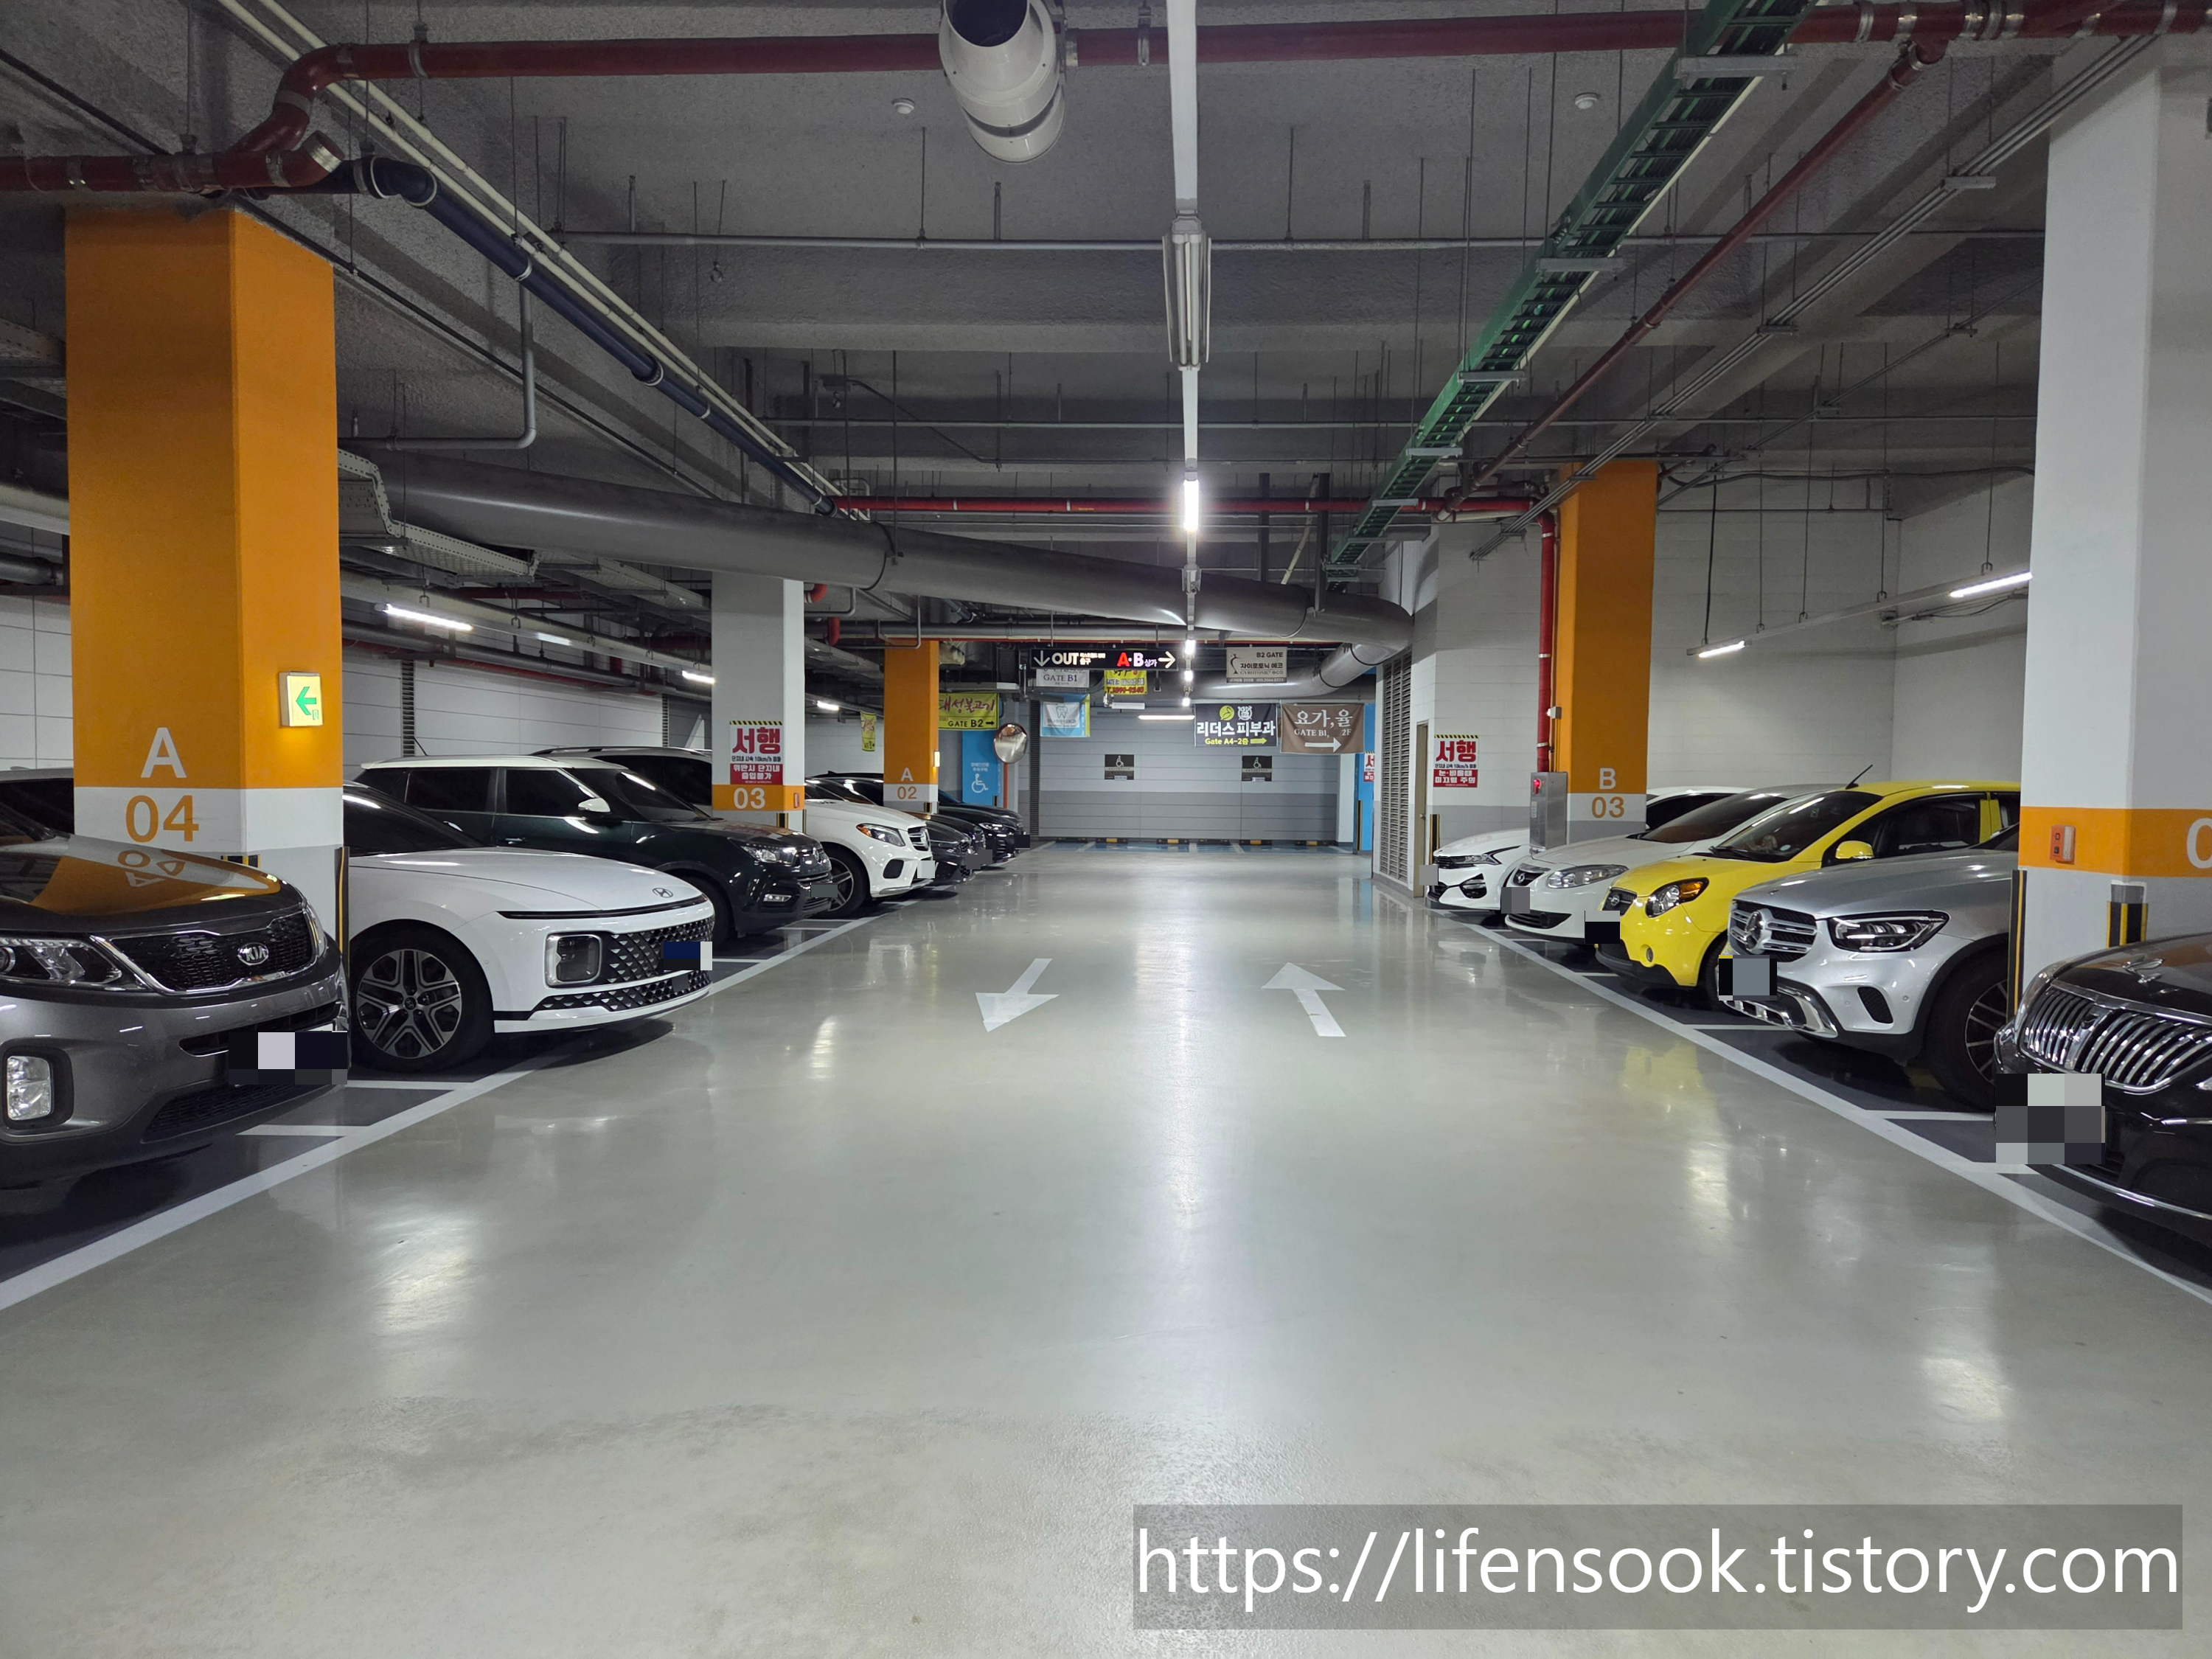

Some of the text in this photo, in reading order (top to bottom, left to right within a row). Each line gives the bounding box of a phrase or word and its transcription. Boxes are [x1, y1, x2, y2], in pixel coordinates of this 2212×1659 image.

[1051, 652, 1079, 665] OUT
[1067, 674, 1077, 682] B1
[970, 719, 984, 727] B2
[1293, 728, 1317, 737] GATE
[732, 726, 781, 754] 서행
[1436, 740, 1477, 762] 서행
[140, 727, 187, 778] A
[900, 768, 914, 782] A
[1599, 767, 1616, 790] B
[734, 787, 765, 809] 03
[897, 786, 917, 799] 02
[1591, 796, 1625, 818] 03
[125, 795, 199, 842] 04
